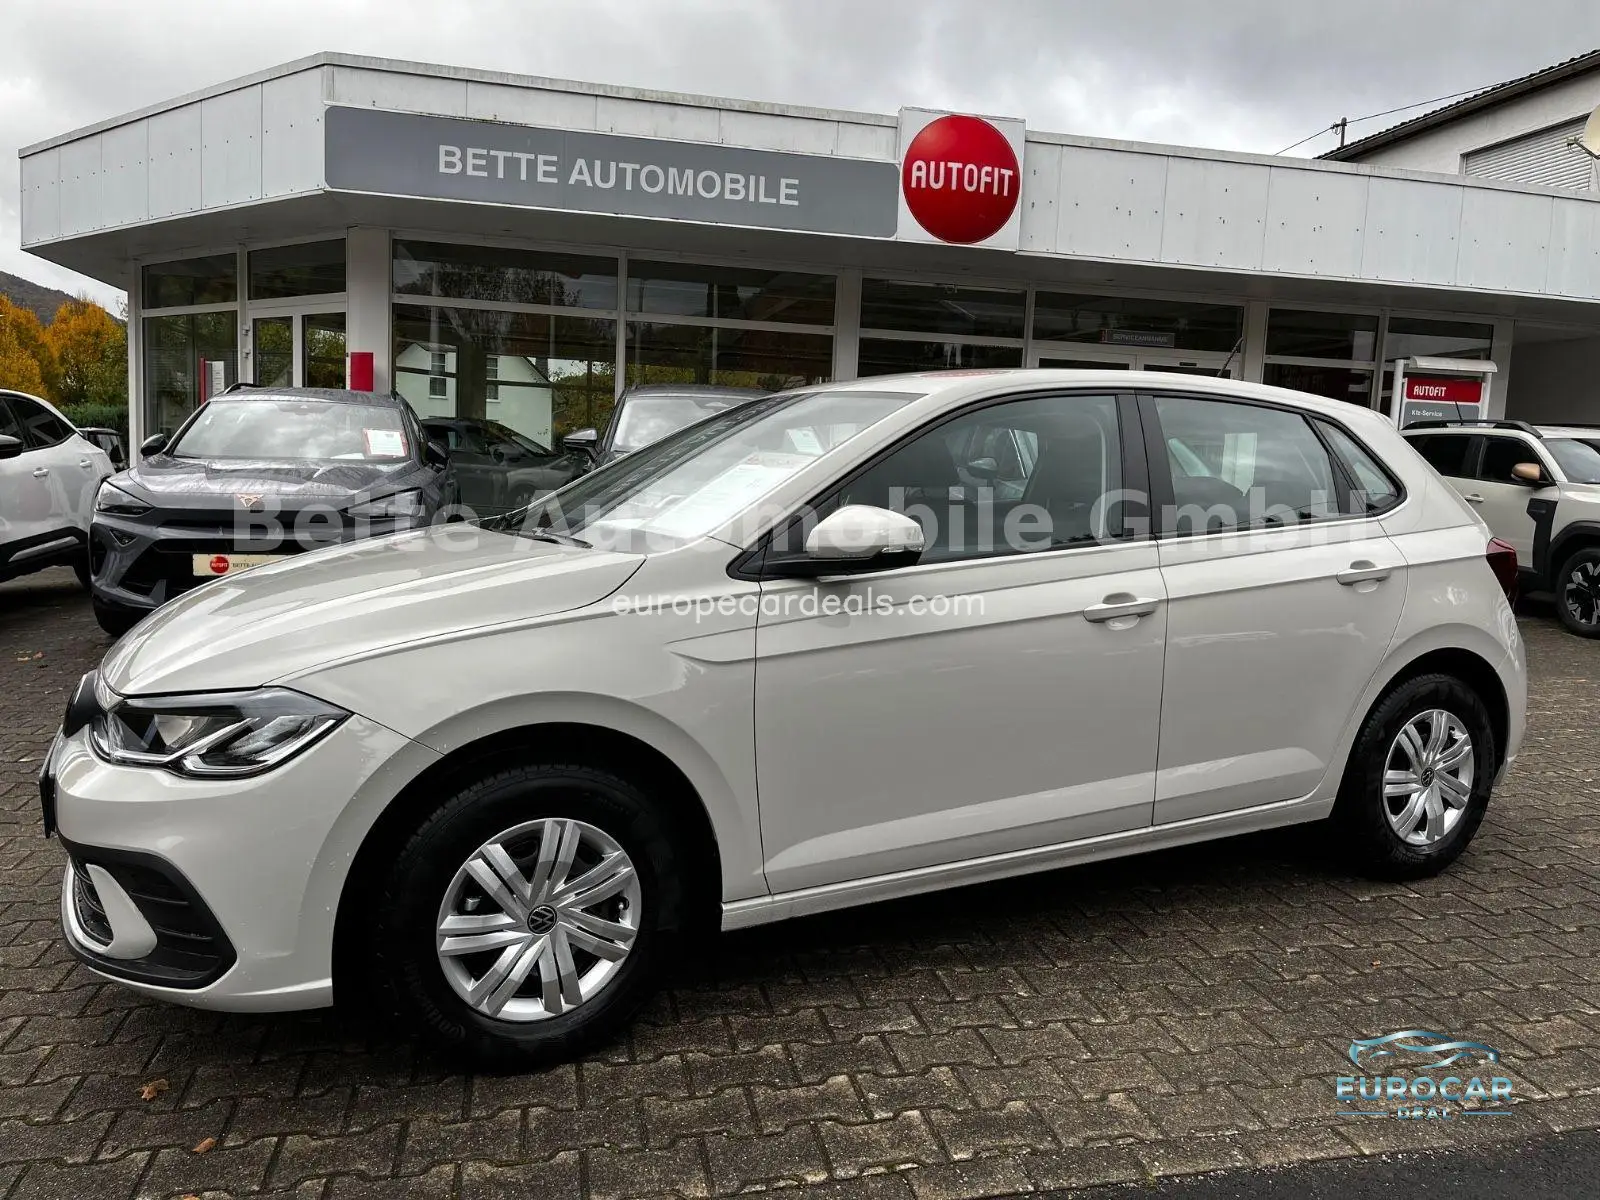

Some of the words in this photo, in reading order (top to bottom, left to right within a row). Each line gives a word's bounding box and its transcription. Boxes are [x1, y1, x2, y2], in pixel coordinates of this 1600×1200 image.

[438, 144, 558, 184] BETTE
[568, 158, 800, 206] AUTOMOBILE
[911, 160, 1014, 197] AUTOFIT
[1413, 385, 1447, 397] AUTOFIT
[1411, 409, 1443, 417] Kfz-Service
